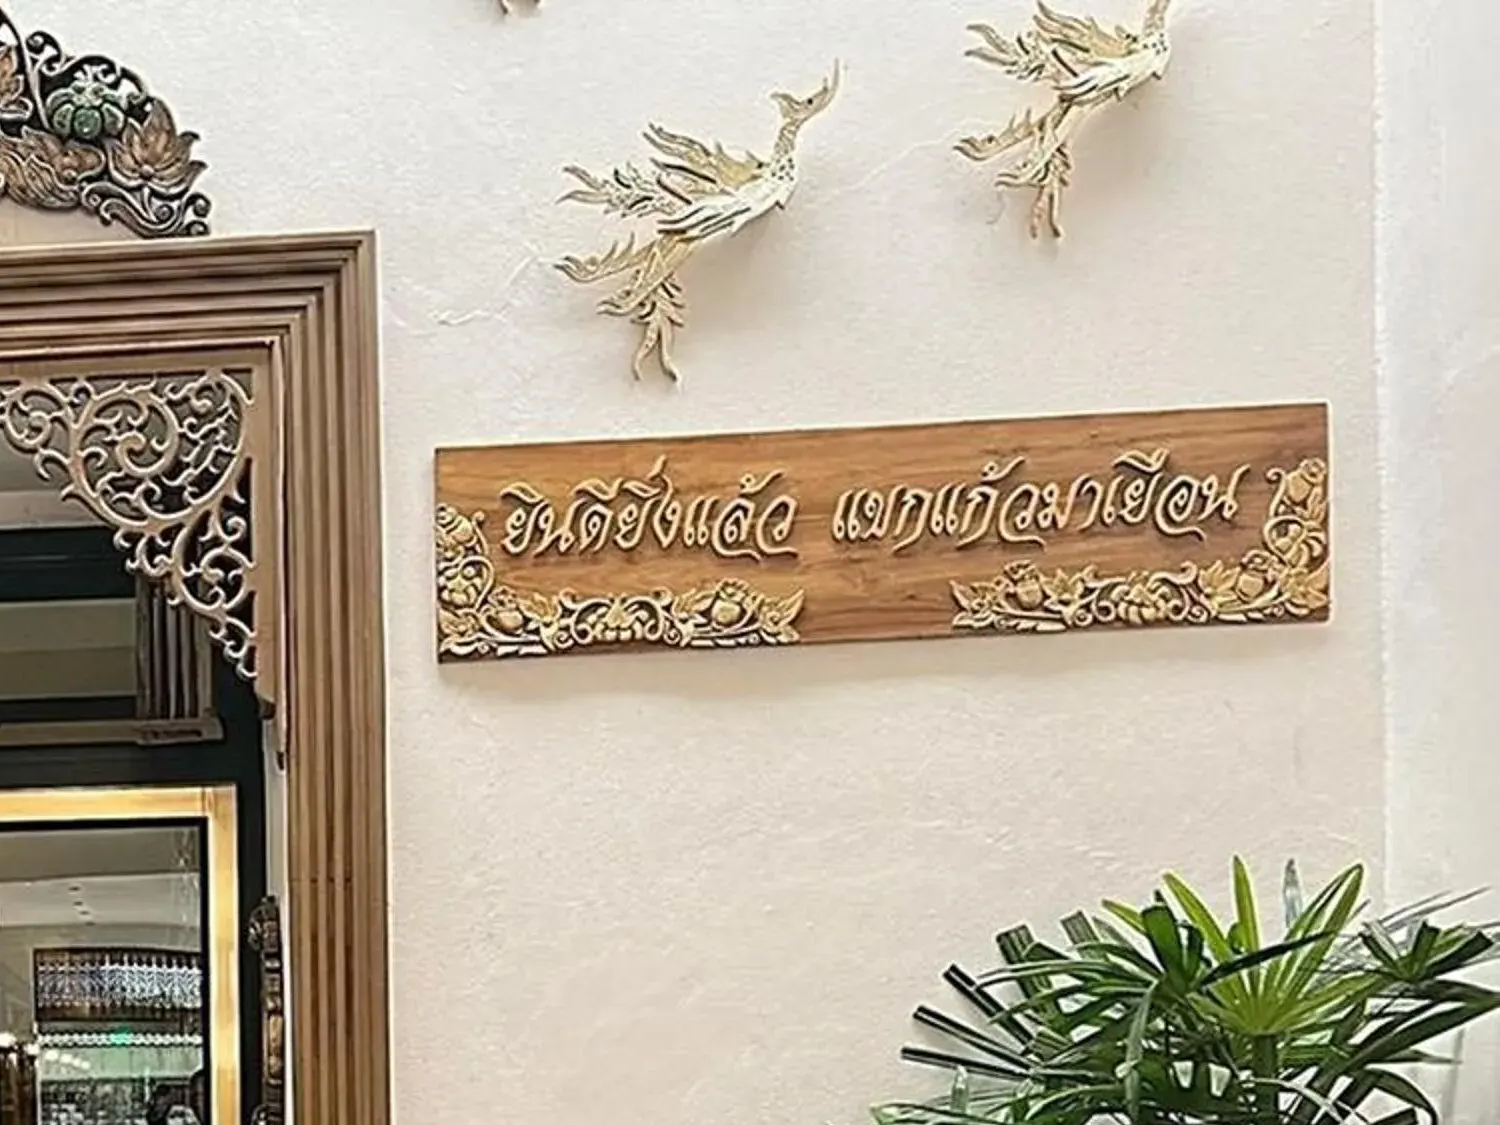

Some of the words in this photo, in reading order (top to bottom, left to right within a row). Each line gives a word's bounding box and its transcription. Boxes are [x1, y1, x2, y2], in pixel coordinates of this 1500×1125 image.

[500, 454, 799, 561] ยินดียิ่งแล้ว
